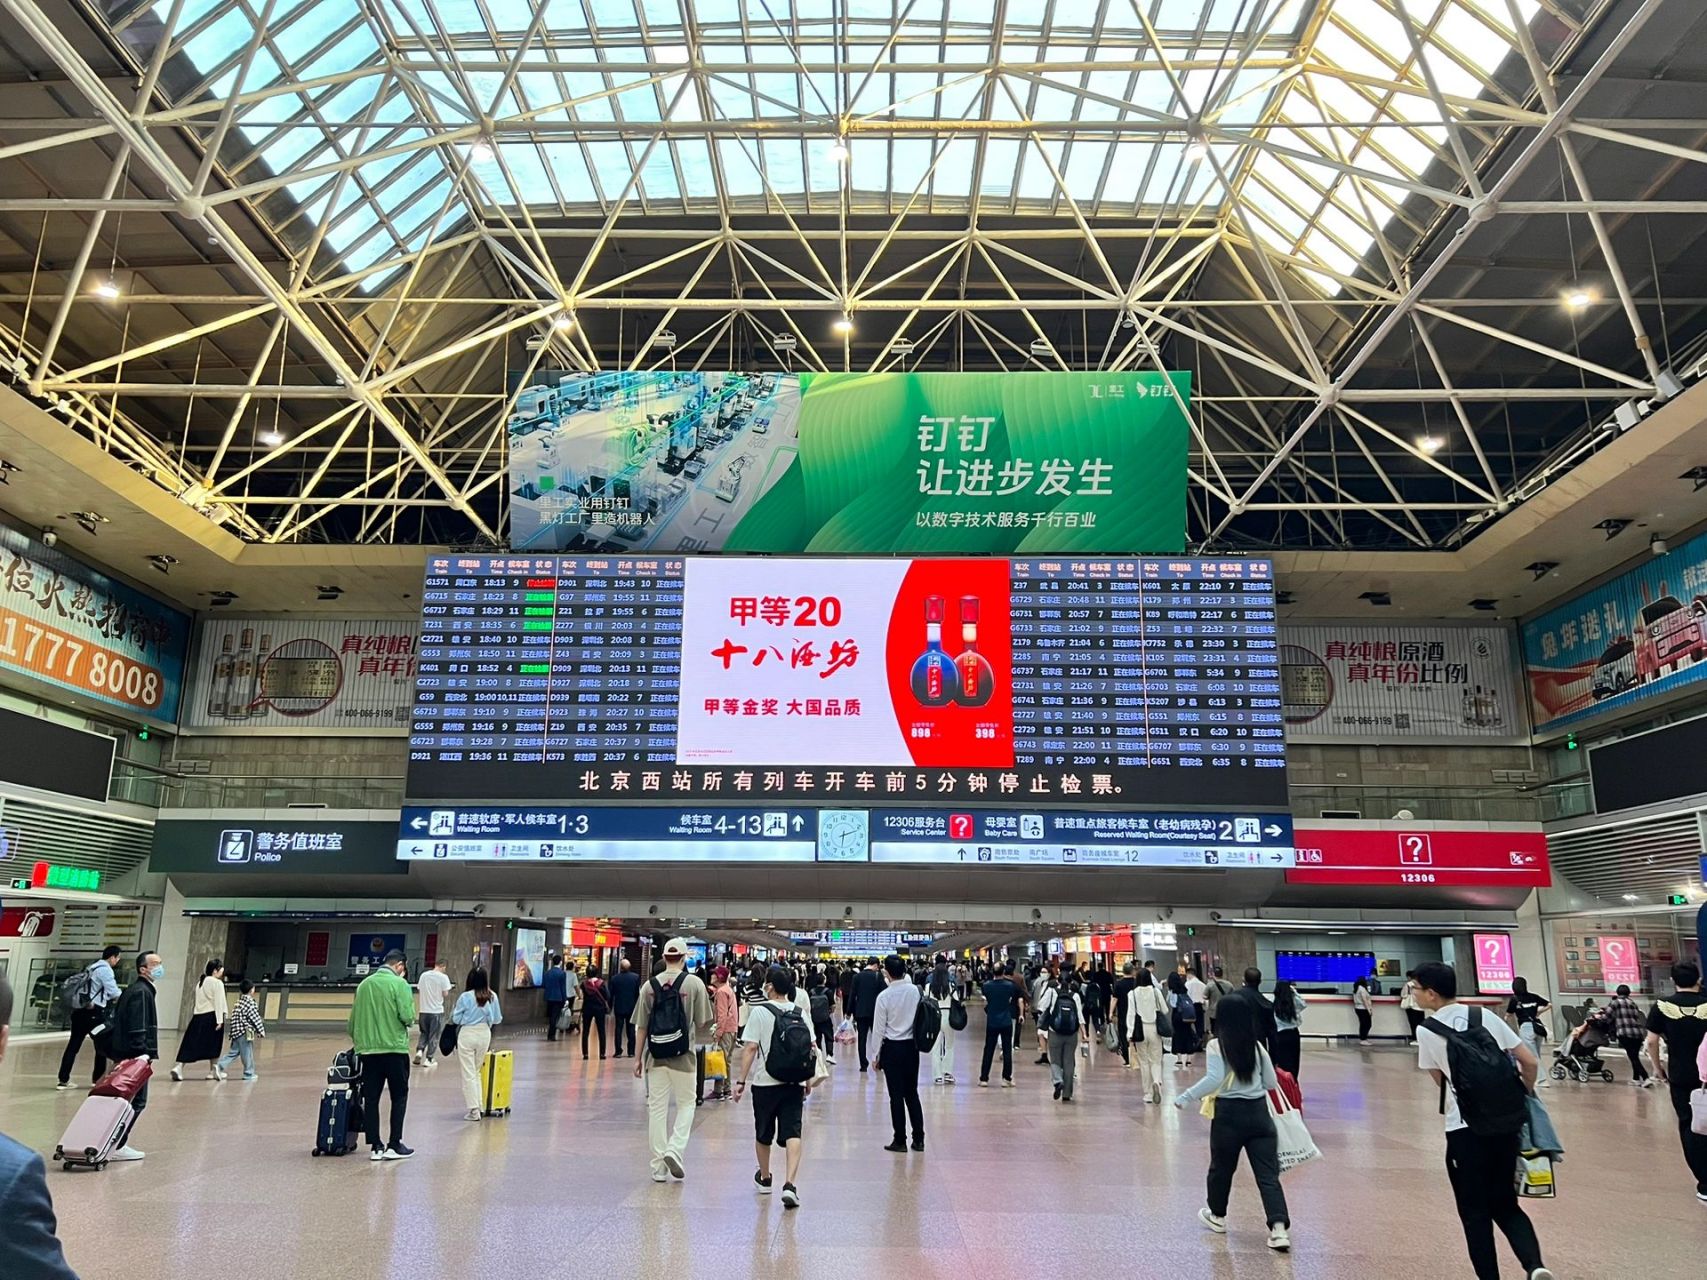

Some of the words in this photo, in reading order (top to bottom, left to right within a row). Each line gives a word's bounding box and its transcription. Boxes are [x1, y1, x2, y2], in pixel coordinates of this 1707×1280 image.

[917, 416, 995, 452] 钉钉
[916, 458, 1113, 496] 让进步发生
[540, 512, 655, 525] 黑灯工厂里造机器人
[915, 511, 1097, 528] 以数字技术服务千行百业
[730, 597, 841, 627] 甲等20
[340, 635, 418, 654] 真纯粮
[1324, 642, 1444, 662] 真纯粮原酒
[89, 652, 158, 705] 8008
[1347, 663, 1467, 683] 真年份比例
[704, 699, 778, 716] 甲等金奖
[786, 699, 861, 716] 大国品质
[976, 729, 995, 738] 398
[1212, 758, 1230, 766] 6:35
[580, 770, 1124, 794] 北京西站所有列车开车前5分钟停止检票。
[681, 815, 712, 825] 候车室
[714, 815, 761, 834] 4-13
[884, 817, 946, 828] 12306服务台
[985, 817, 1017, 827] 母婴室
[1219, 821, 1233, 840] 2
[257, 832, 342, 850] 警务值班室
[255, 852, 281, 861] Police
[1126, 850, 1138, 861] 12
[1401, 874, 1435, 882] 12306
